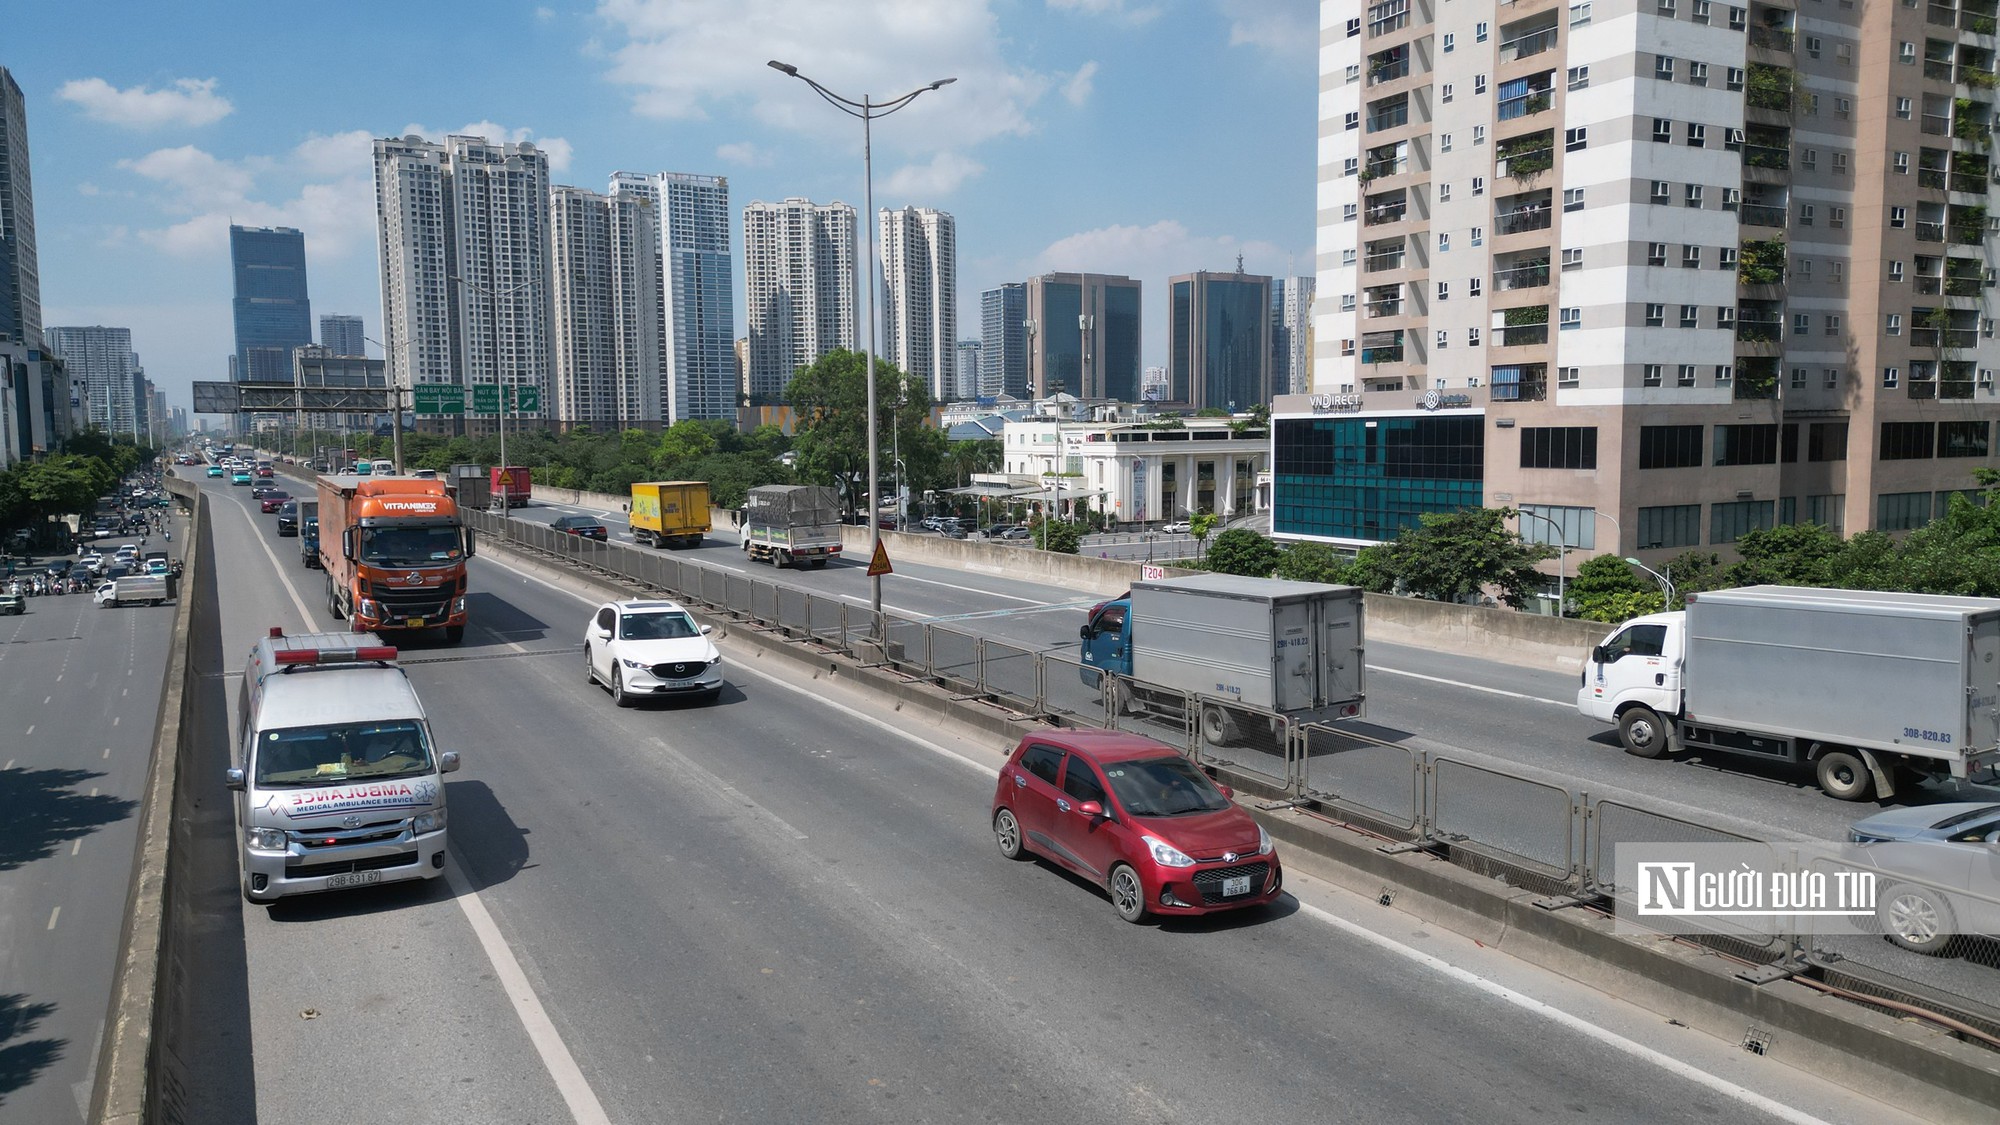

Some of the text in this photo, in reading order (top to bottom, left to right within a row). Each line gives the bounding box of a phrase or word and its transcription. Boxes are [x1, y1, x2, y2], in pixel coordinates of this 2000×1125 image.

[1309, 393, 1360, 408] VNDIRECT
[1903, 727, 1951, 743] 30B-820.83
[297, 803, 334, 812] MEDICAL
[337, 799, 381, 808] AMBULANCE
[329, 872, 379, 887] 29B-631.87
